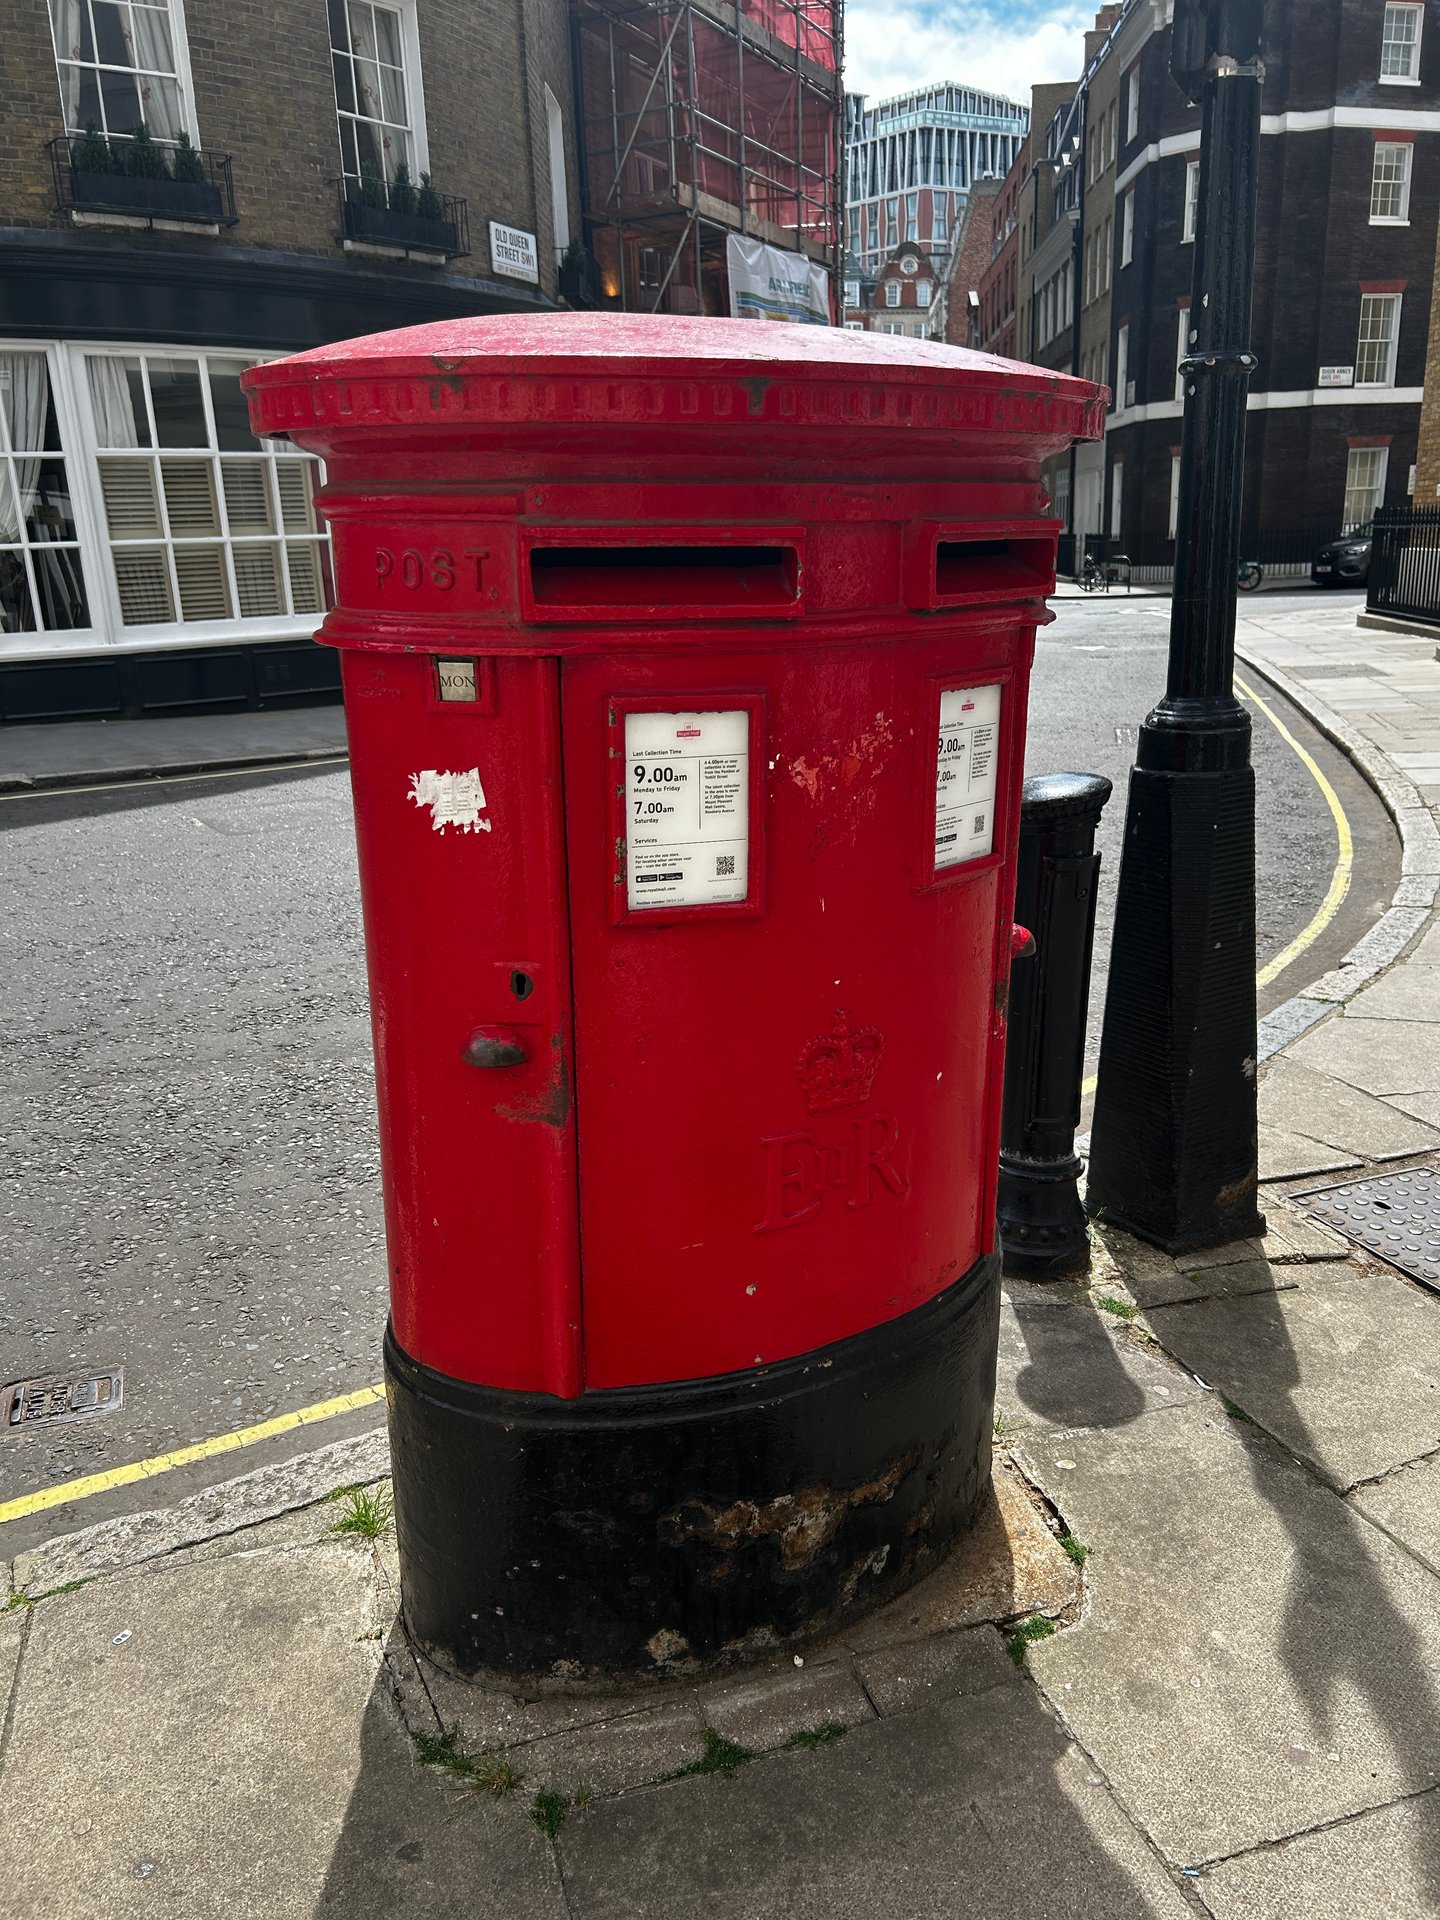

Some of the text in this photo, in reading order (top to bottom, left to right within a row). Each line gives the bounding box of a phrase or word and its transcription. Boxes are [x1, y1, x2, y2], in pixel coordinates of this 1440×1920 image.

[495, 228, 530, 251] OLD QUEEN
[496, 244, 535, 267] STREET SW1
[376, 548, 491, 593] POST
[440, 675, 476, 688] MON
[938, 737, 965, 755] 9.00am
[633, 765, 688, 784] 9.00am
[663, 785, 681, 793] Friday
[634, 801, 675, 815] 7.00am
